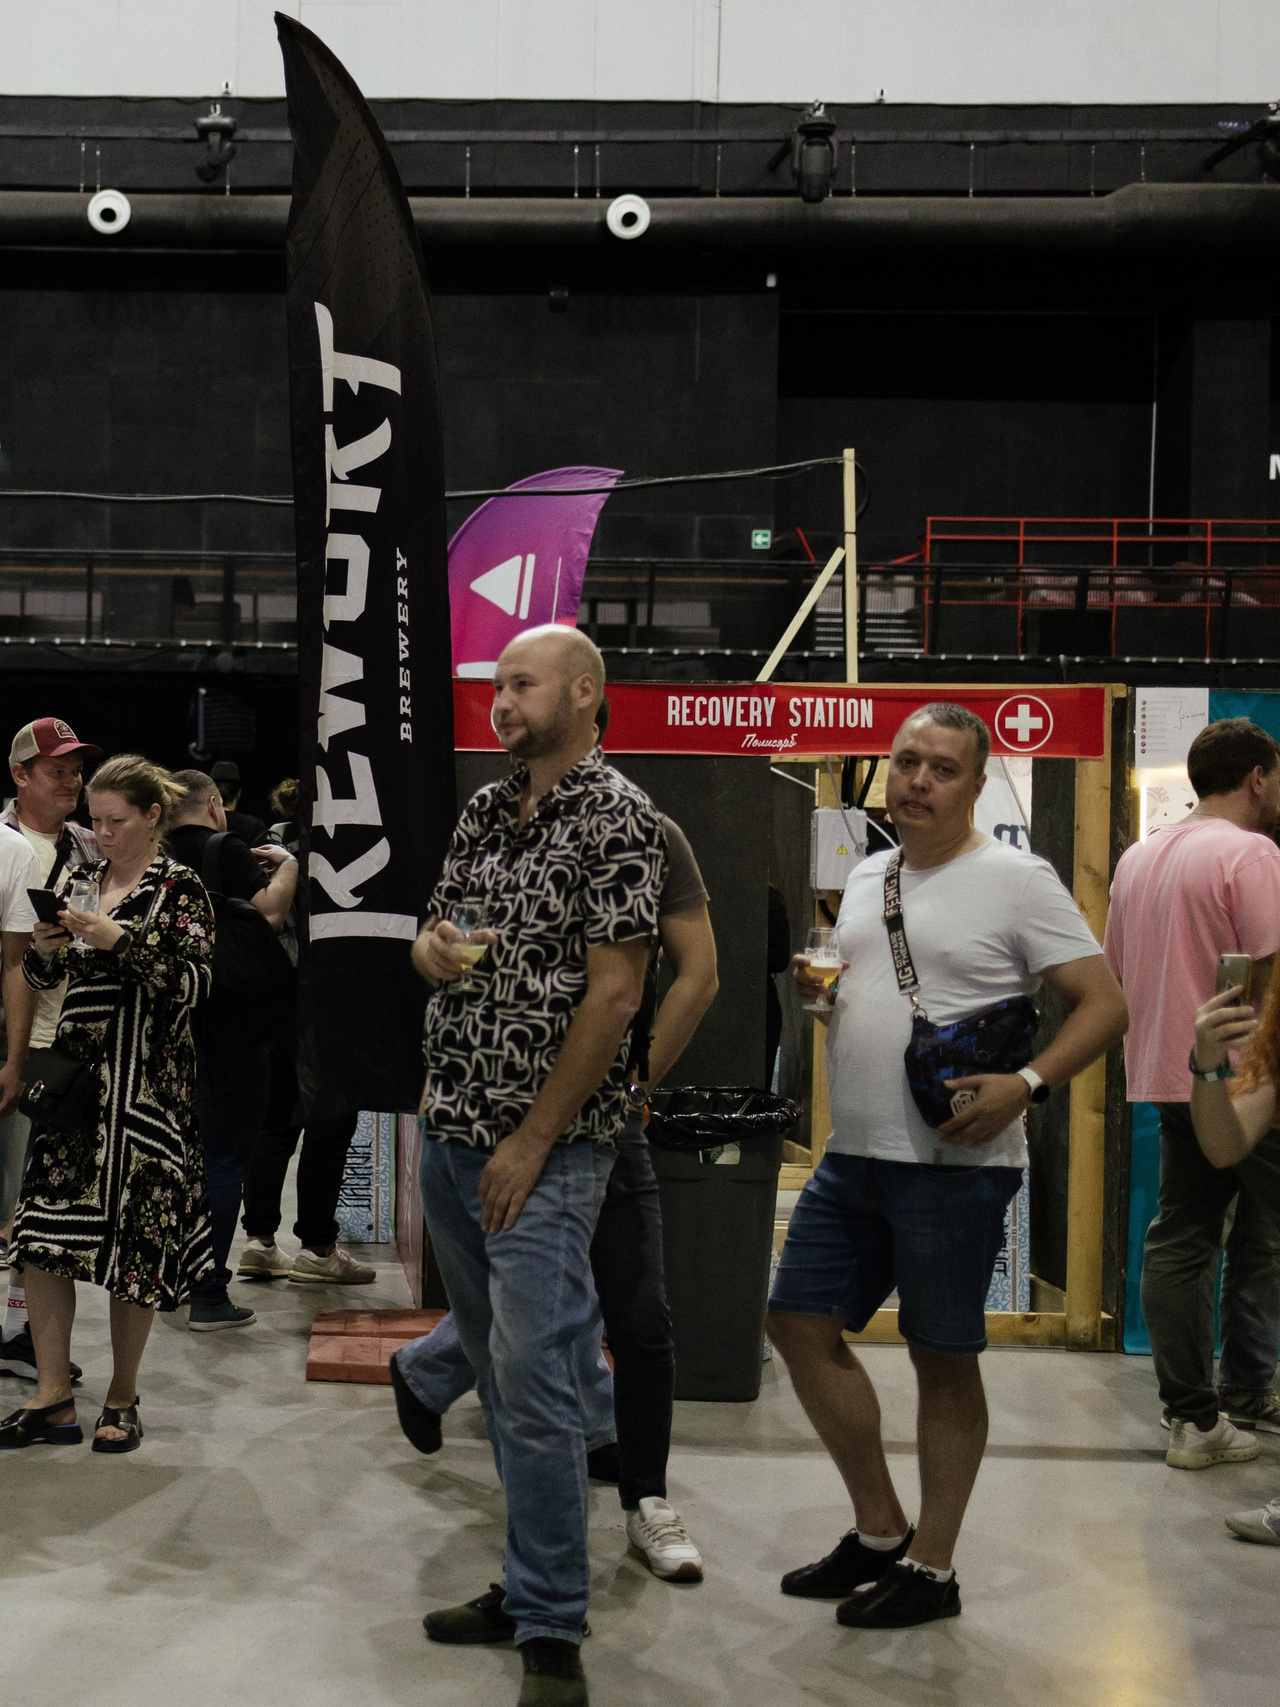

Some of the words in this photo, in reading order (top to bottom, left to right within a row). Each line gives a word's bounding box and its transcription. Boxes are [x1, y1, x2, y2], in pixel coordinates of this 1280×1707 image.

[396, 547, 413, 744] BREWERY
[667, 695, 776, 727] RECOVERY
[788, 697, 873, 729] STATION
[741, 733, 799, 752] Полисорб
